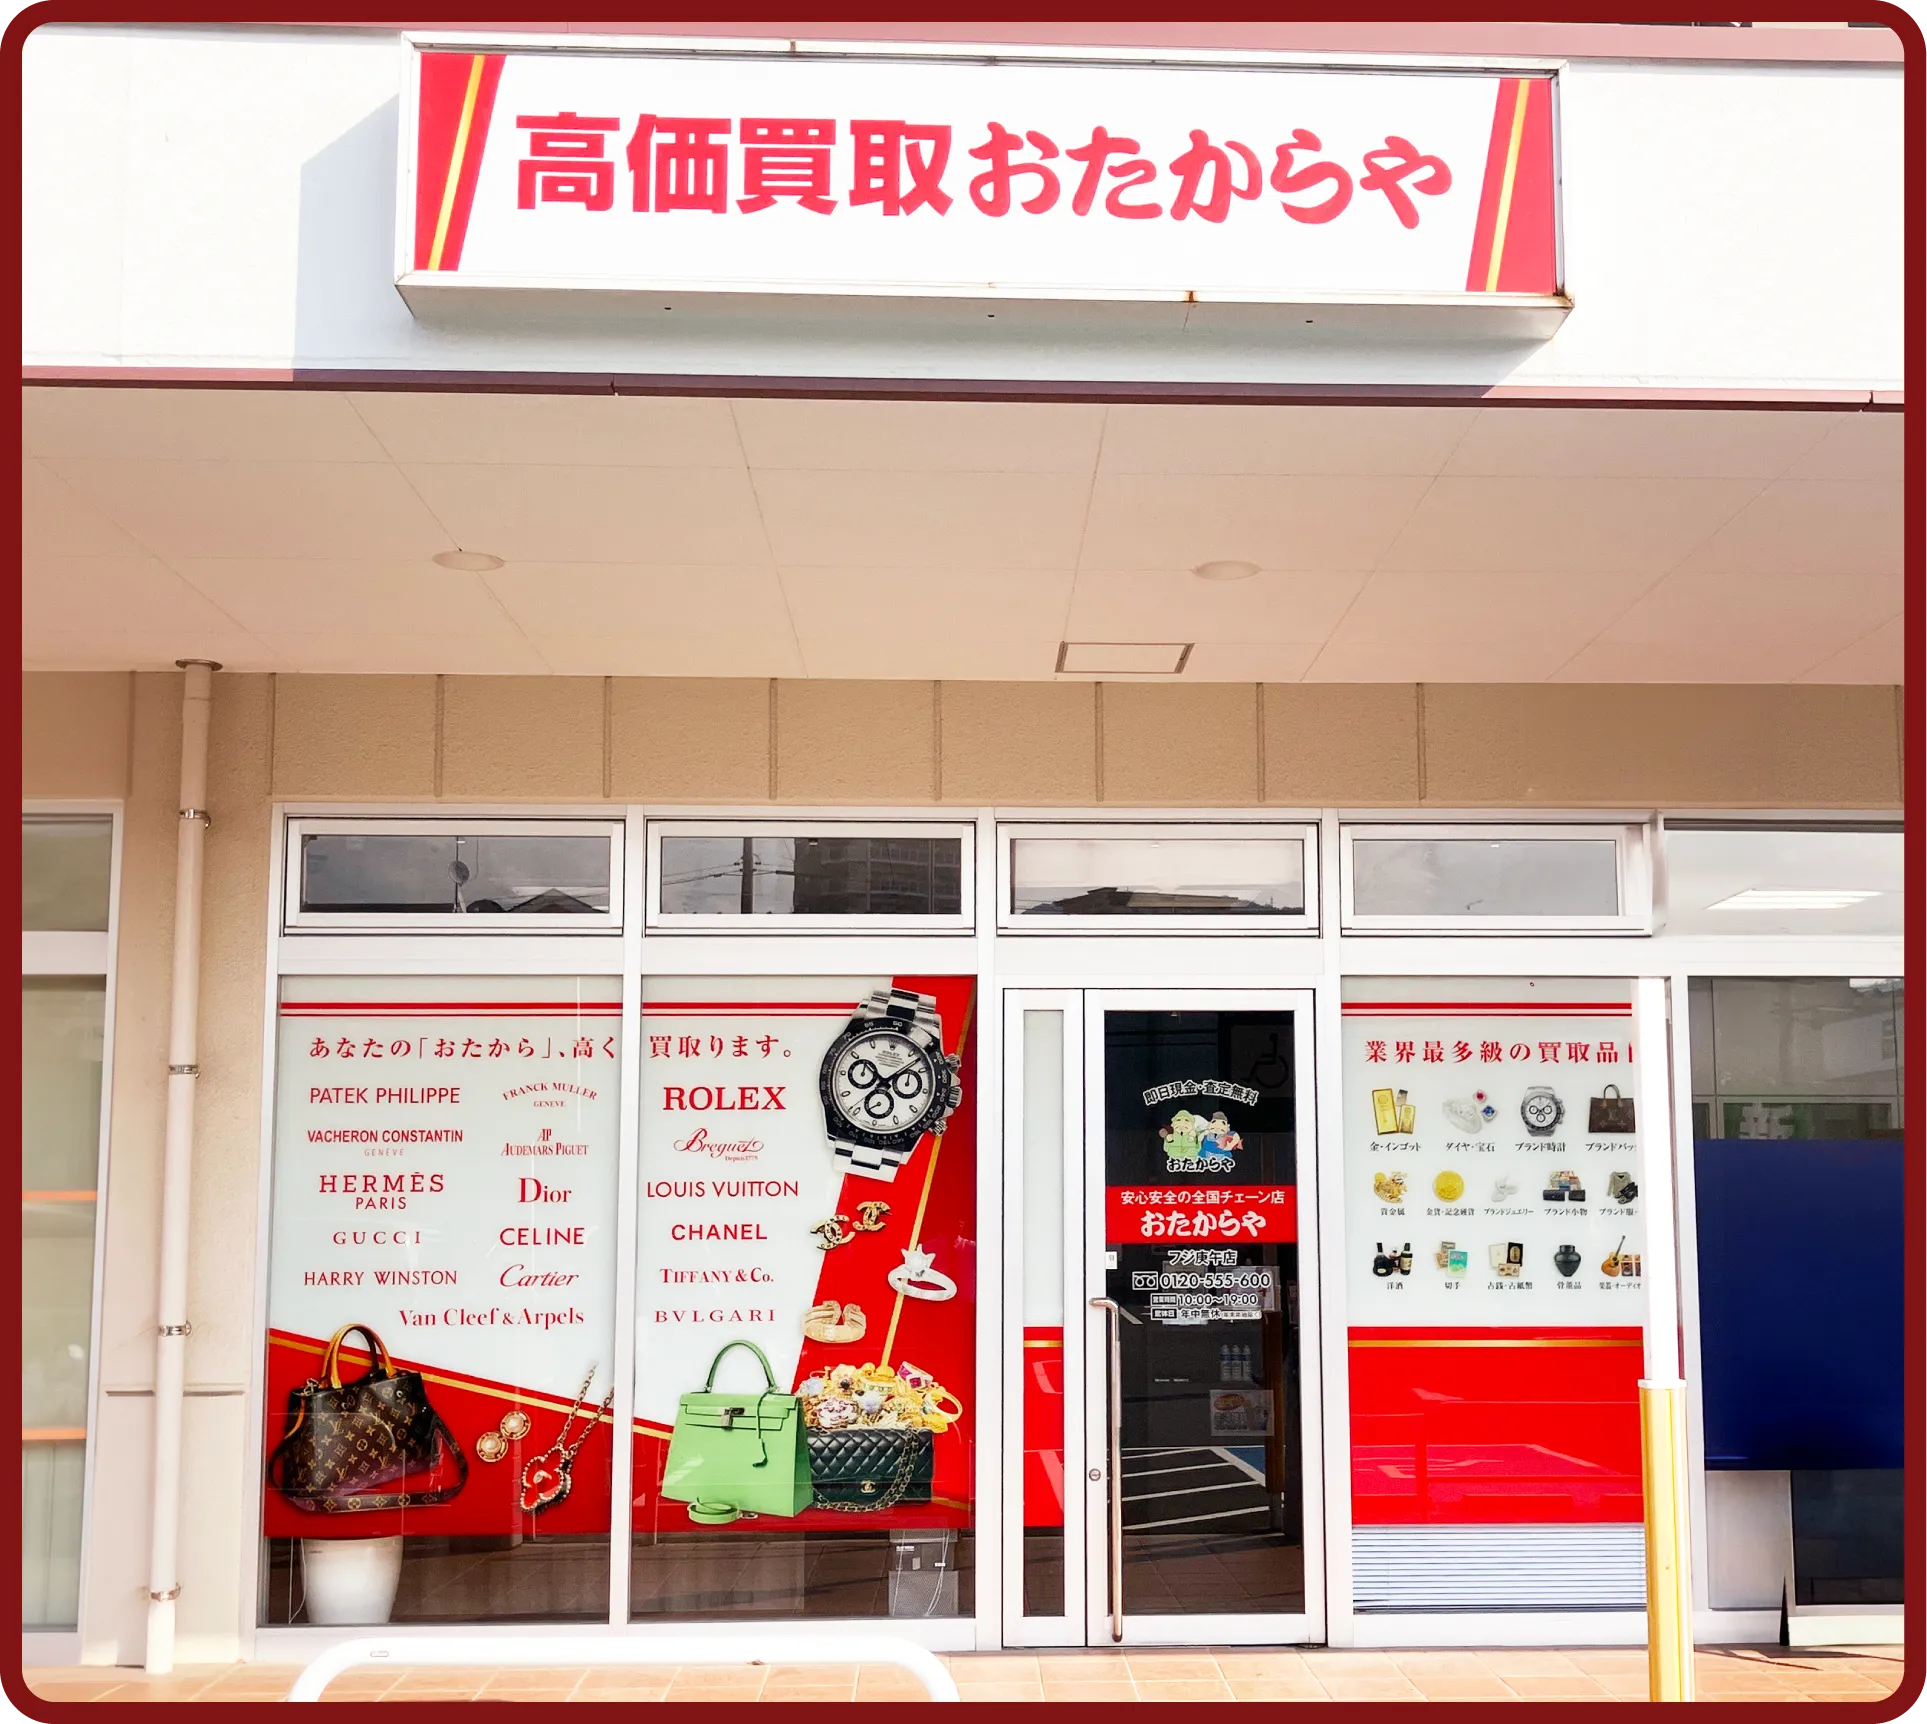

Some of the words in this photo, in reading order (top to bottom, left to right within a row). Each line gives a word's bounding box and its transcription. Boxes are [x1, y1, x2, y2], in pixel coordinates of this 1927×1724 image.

[649, 1035, 792, 1059] 買取ります。
[1365, 1040, 1633, 1064] 業界最多級の買取品
[310, 1088, 368, 1104] PATEK
[376, 1088, 460, 1104] PHILIPPE
[502, 1082, 549, 1101] FRANCK
[552, 1082, 598, 1100] MULLER
[663, 1086, 786, 1110] ROLEX
[307, 1129, 378, 1143] VACHERON
[382, 1129, 463, 1143] CONSTANTIN
[673, 1127, 764, 1159] Breguet
[501, 1142, 554, 1156] AUDEMARS
[555, 1142, 589, 1156] PIGUET
[1370, 1141, 1421, 1152] 金・インゴット
[1446, 1141, 1495, 1152] ダイヤ・宝石
[1514, 1141, 1566, 1152] ブランド時計
[1585, 1141, 1637, 1152] ブランドバッ
[1166, 1157, 1236, 1173] おたからや
[517, 1177, 573, 1204] Dior
[647, 1182, 707, 1198] LOUIS
[712, 1181, 799, 1198] VUITTON
[355, 1196, 407, 1210] PARIS
[1121, 1190, 1286, 1206] 安心安全の全国チェーン店
[1544, 1207, 1589, 1217] ブランド小物
[1140, 1209, 1267, 1238] おたからや
[332, 1231, 422, 1246] GUCCI
[500, 1228, 585, 1246] CELINE
[671, 1224, 768, 1241] CHANEL
[304, 1271, 365, 1288] HARRY
[374, 1270, 458, 1286] WINSTON
[500, 1264, 580, 1288] Cartier
[659, 1268, 732, 1284] TIFFANY
[735, 1268, 748, 1283] &
[750, 1267, 775, 1283] Co.
[1160, 1273, 1271, 1289] 0120-555-600
[399, 1309, 436, 1326] Van
[443, 1308, 499, 1326] Cleef
[502, 1311, 514, 1325] &
[517, 1307, 585, 1330] Arpels
[654, 1308, 776, 1323] BVLGARI
